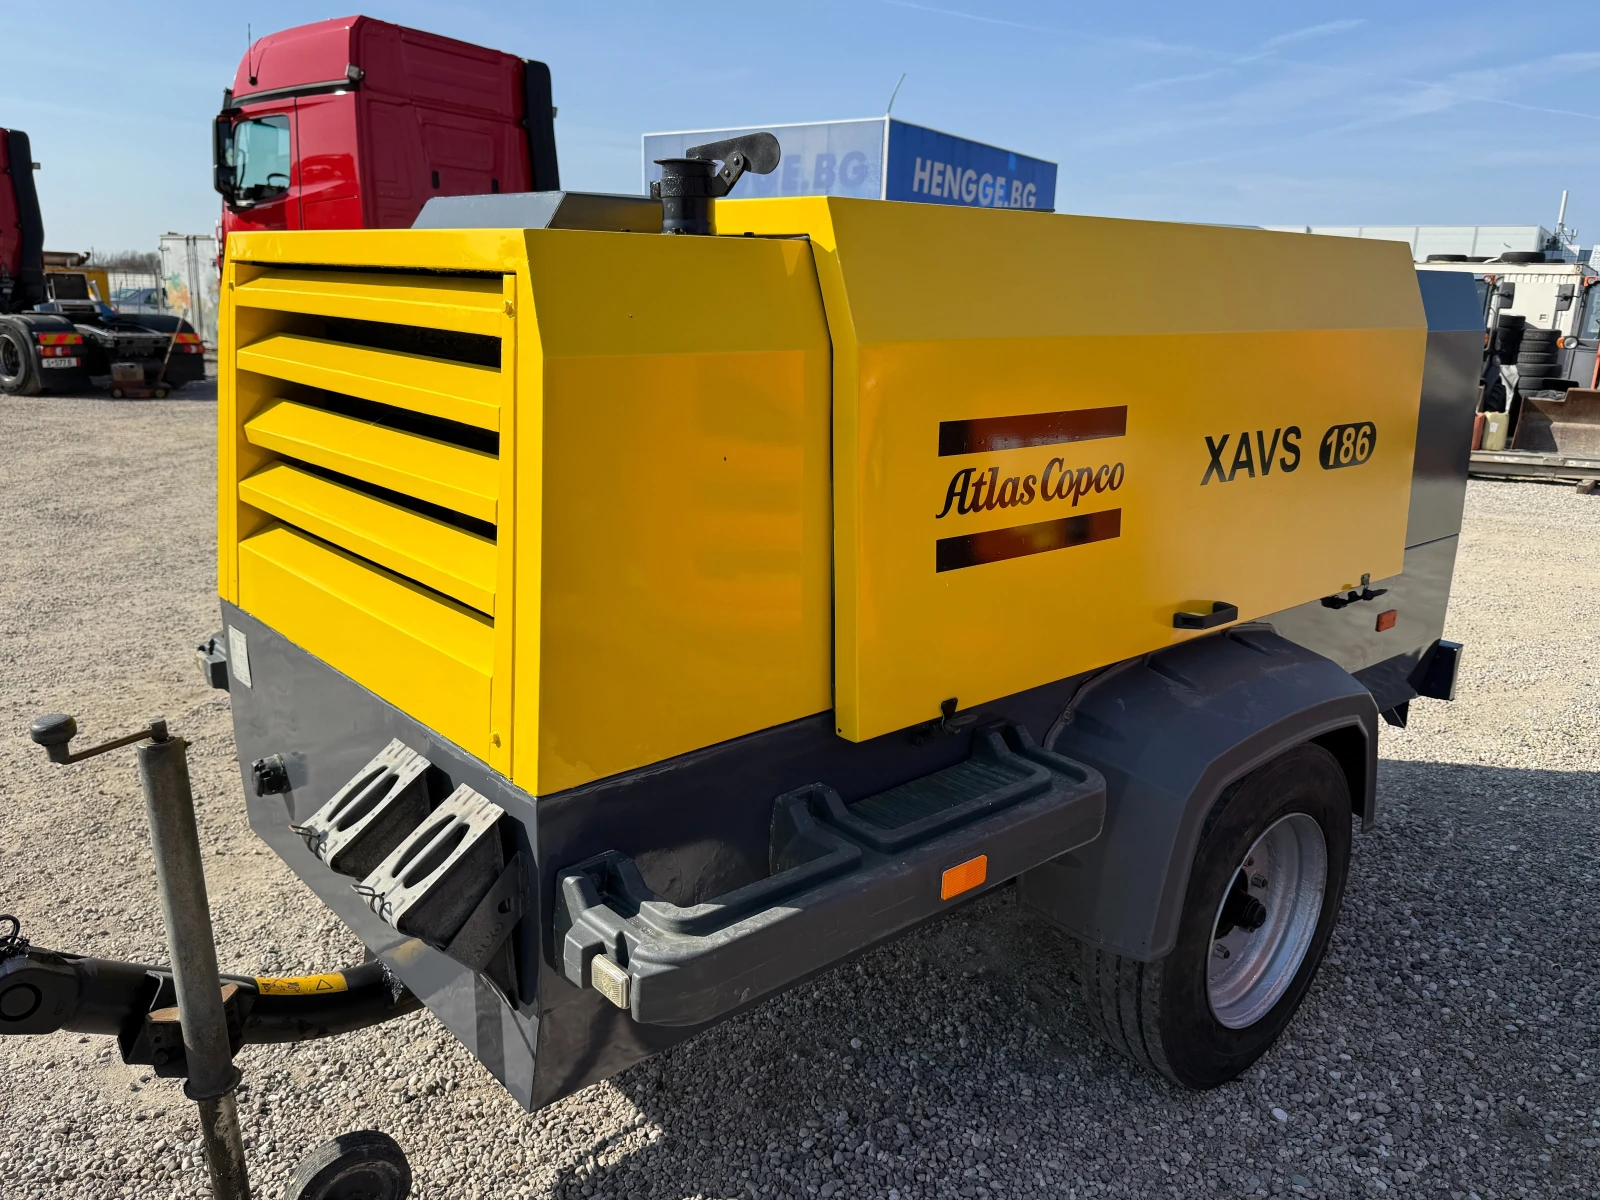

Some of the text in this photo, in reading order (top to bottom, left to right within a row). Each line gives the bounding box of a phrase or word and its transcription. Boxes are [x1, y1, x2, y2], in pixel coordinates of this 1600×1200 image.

[912, 157, 1037, 208] HENGGE.BG
[1200, 425, 1371, 486] XAVS 186
[935, 457, 1125, 519] Atlas Copco
